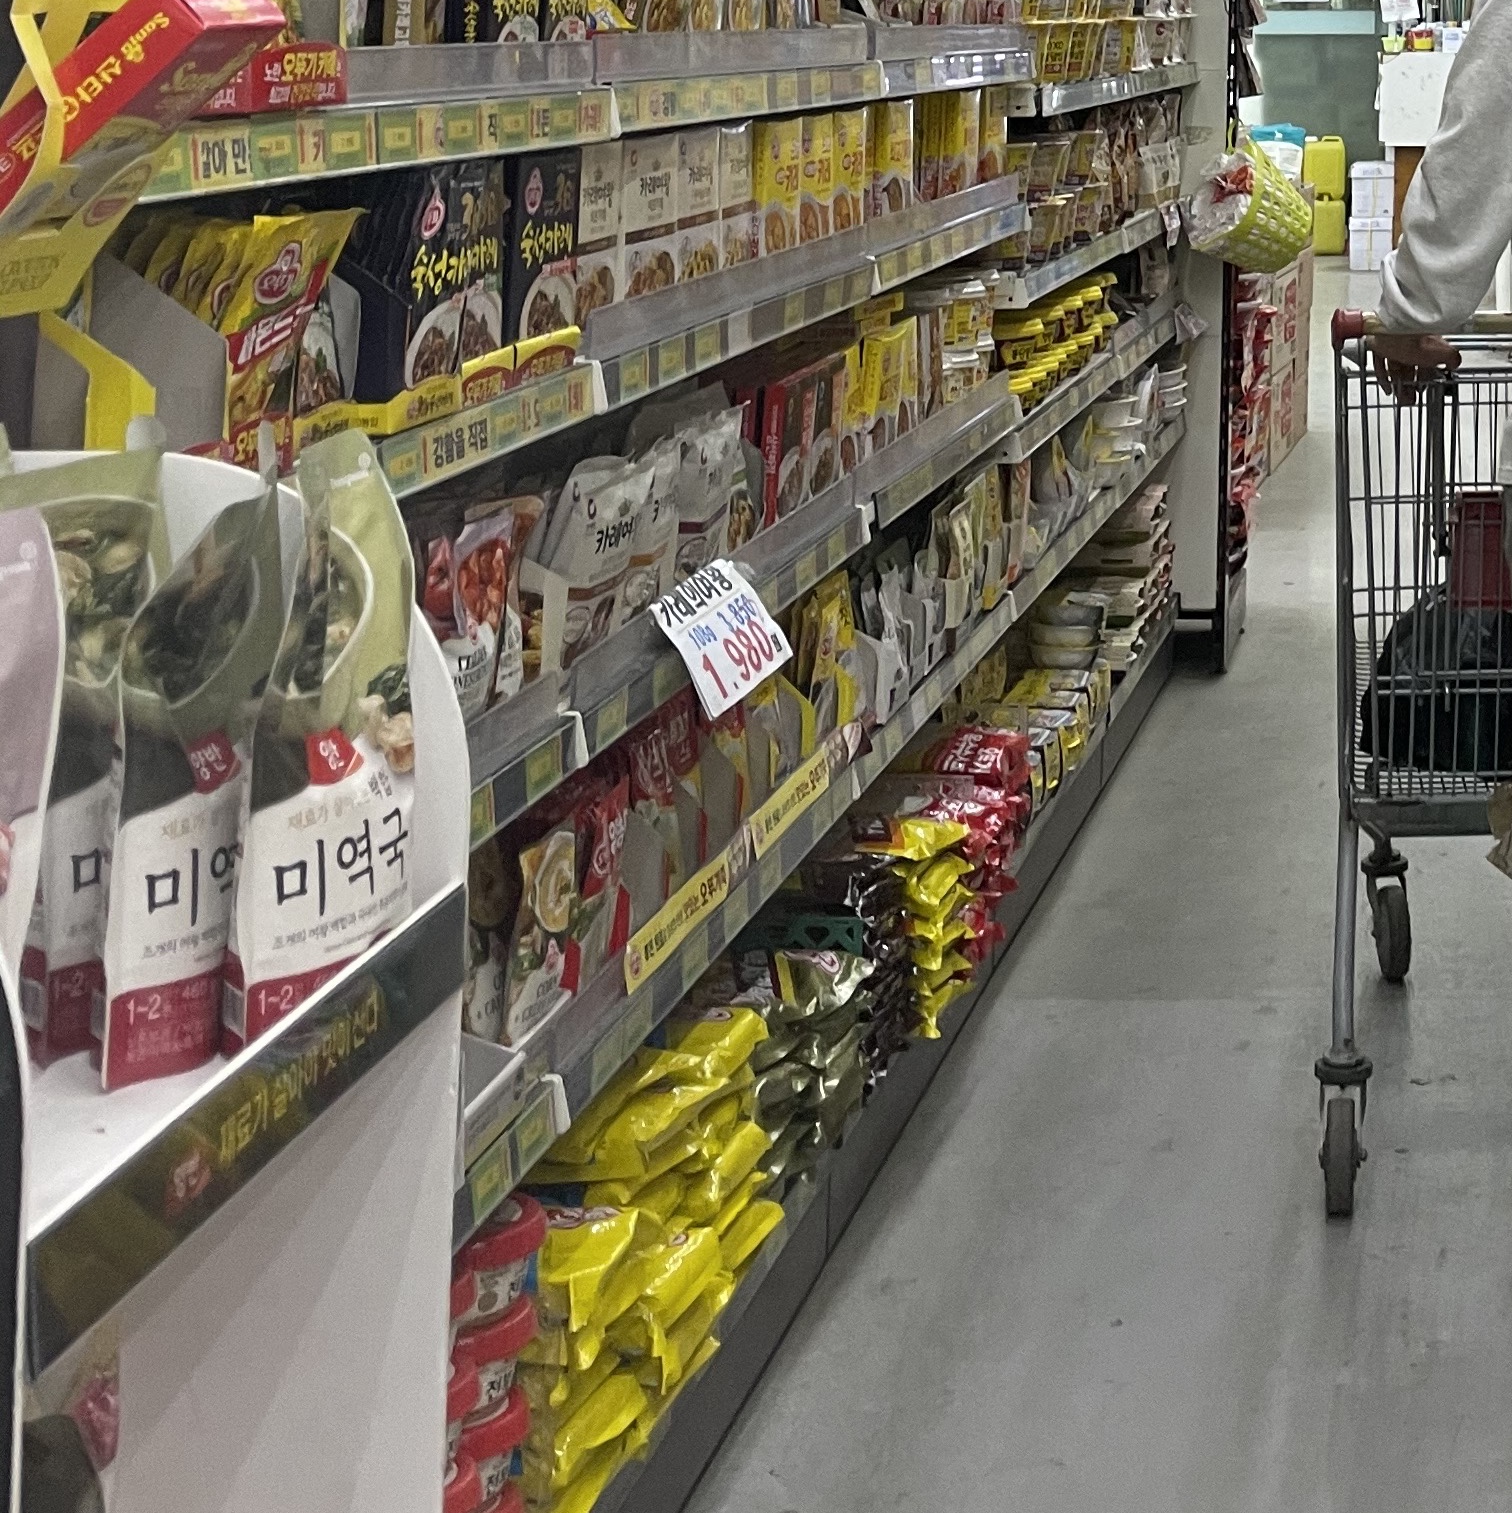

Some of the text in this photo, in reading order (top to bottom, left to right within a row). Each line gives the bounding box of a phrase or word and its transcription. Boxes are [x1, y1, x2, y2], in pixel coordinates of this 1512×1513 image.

[658, 566, 733, 628] 카레의여왕
[190, 742, 227, 781] 양반
[273, 808, 409, 917] 미역국
